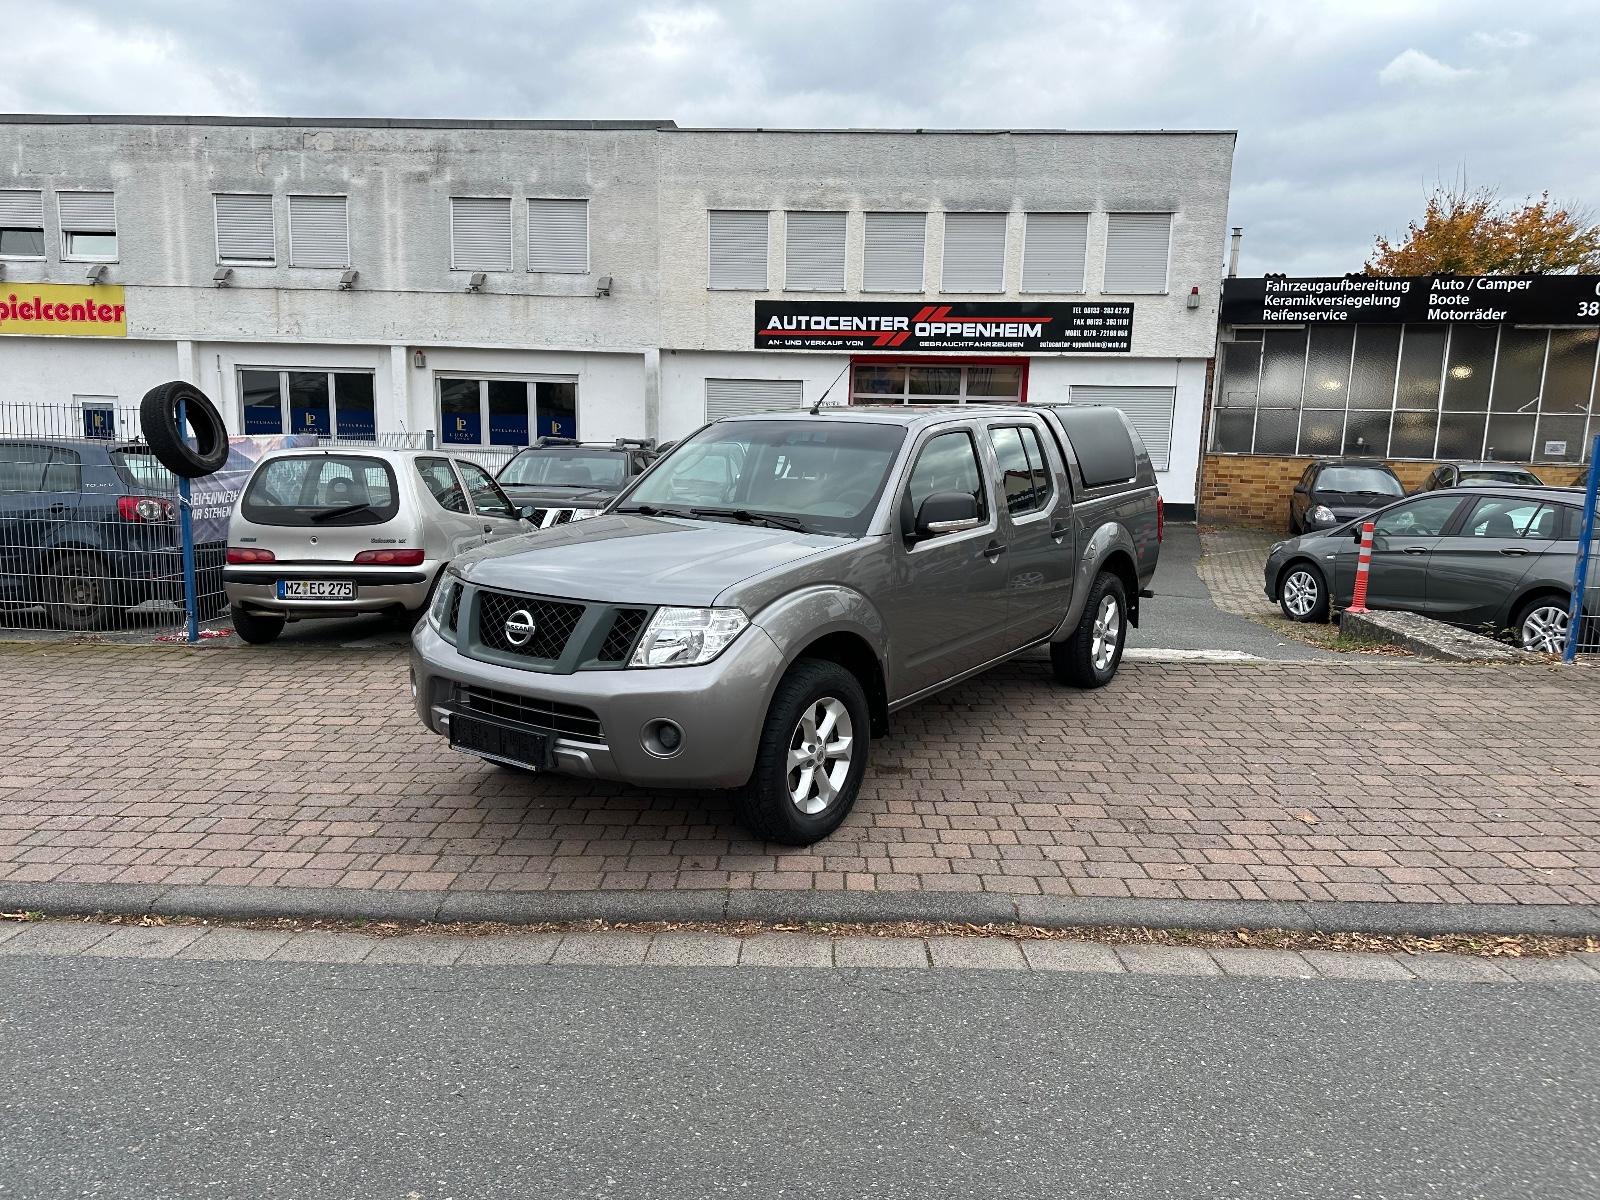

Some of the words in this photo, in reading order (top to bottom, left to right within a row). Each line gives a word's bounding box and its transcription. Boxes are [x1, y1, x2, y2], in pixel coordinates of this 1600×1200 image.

[1265, 279, 1411, 294] Fahrzeugaufbereitung
[1431, 278, 1465, 290] Auto
[1467, 278, 1475, 290] /
[1476, 278, 1533, 292] Camper
[1264, 294, 1401, 308] Keramikversiegelung
[1429, 293, 1470, 305] Boote
[1072, 306, 1081, 314] TEL
[1262, 309, 1348, 320] Reifenservice
[1427, 308, 1508, 320] Motorräder
[1577, 301, 1600, 317] 38
[766, 315, 909, 331] AUTOCENTER
[914, 322, 1042, 338] OPPENHEIM
[1073, 318, 1085, 326] FAX
[1064, 329, 1082, 337] MOBIL
[203, 505, 232, 519] STEHEN
[285, 582, 302, 595] MZ
[309, 582, 326, 596] EC
[328, 583, 352, 596] 275
